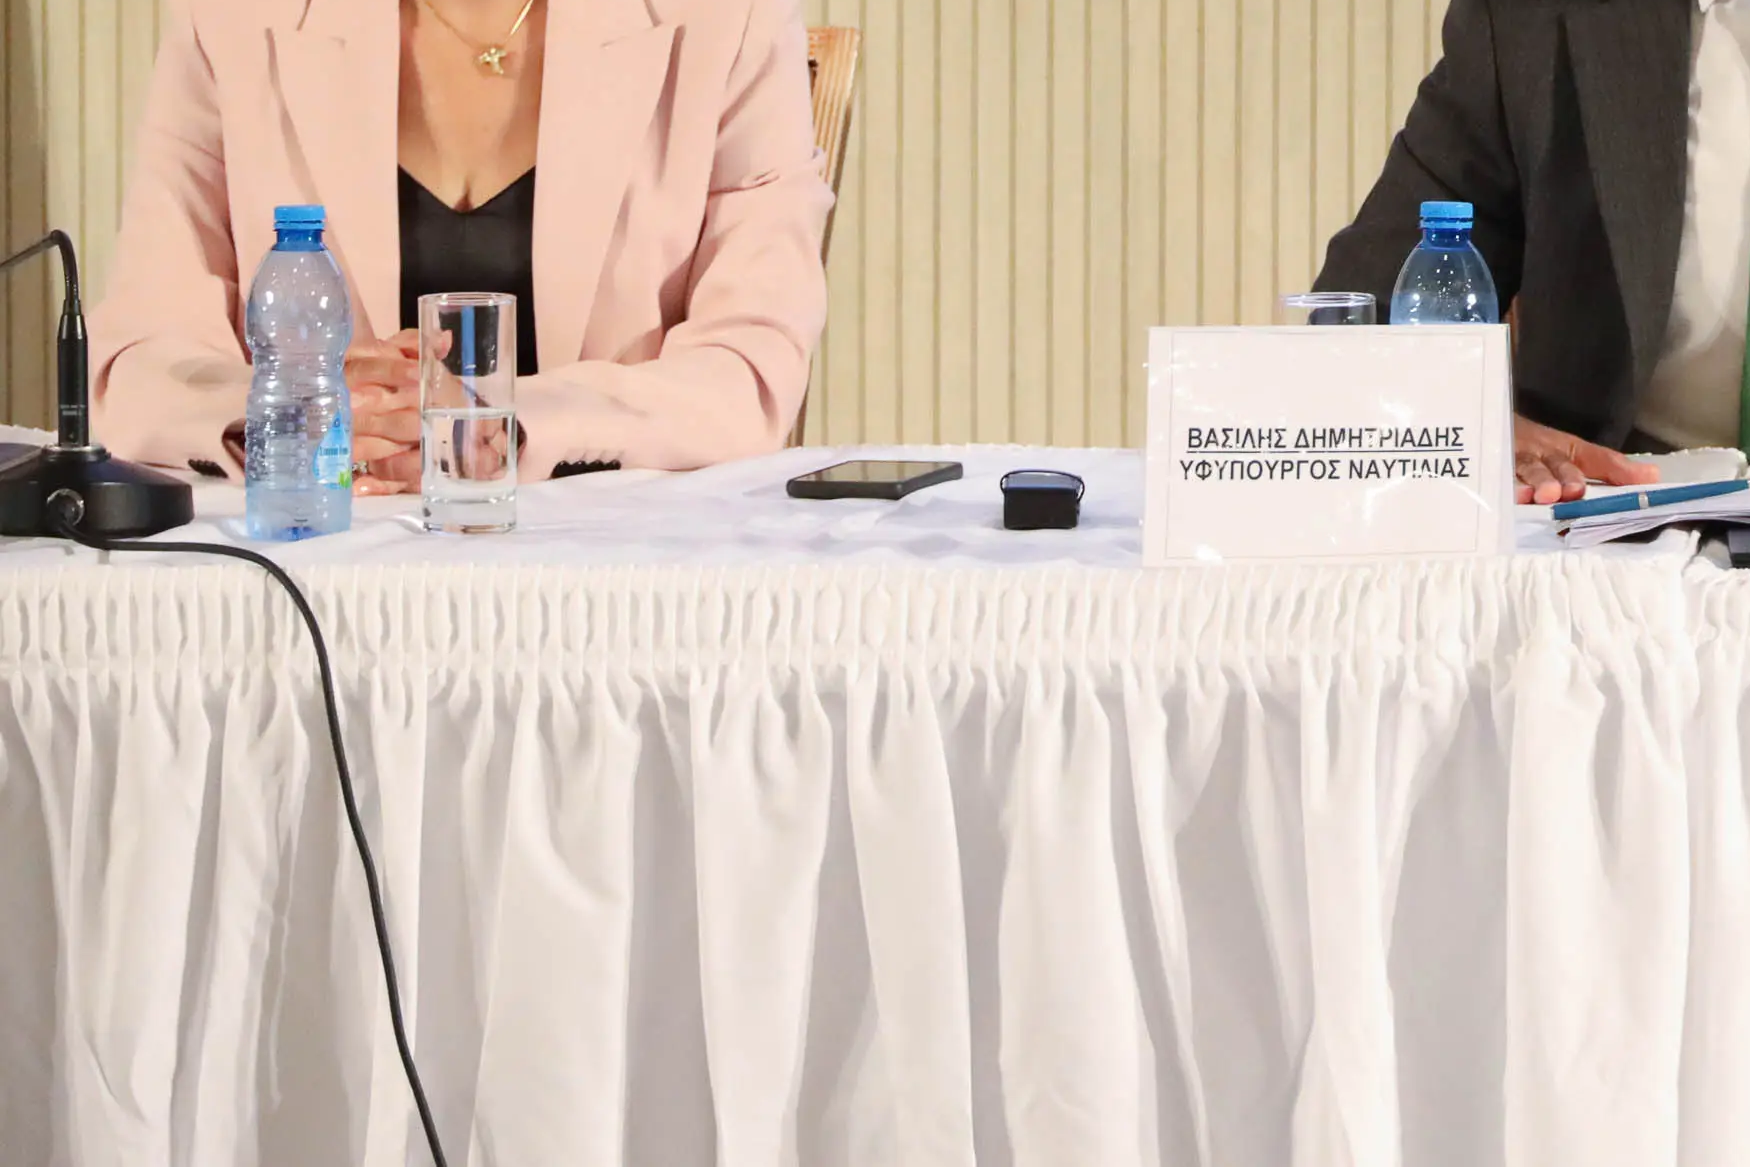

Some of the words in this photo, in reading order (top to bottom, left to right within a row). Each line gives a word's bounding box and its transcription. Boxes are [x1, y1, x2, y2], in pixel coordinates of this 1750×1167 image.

[1187, 428, 1287, 449] ΒΑΣΙΛΗΣ
[1294, 427, 1464, 448] ΔΗΜΗΤΡΙΑΔΗΣ
[1180, 459, 1340, 481] ΥΦΥΠΟΥΡΓΟΣ
[1349, 458, 1470, 479] ΝΑΥΤΙΛΙΑΣ
